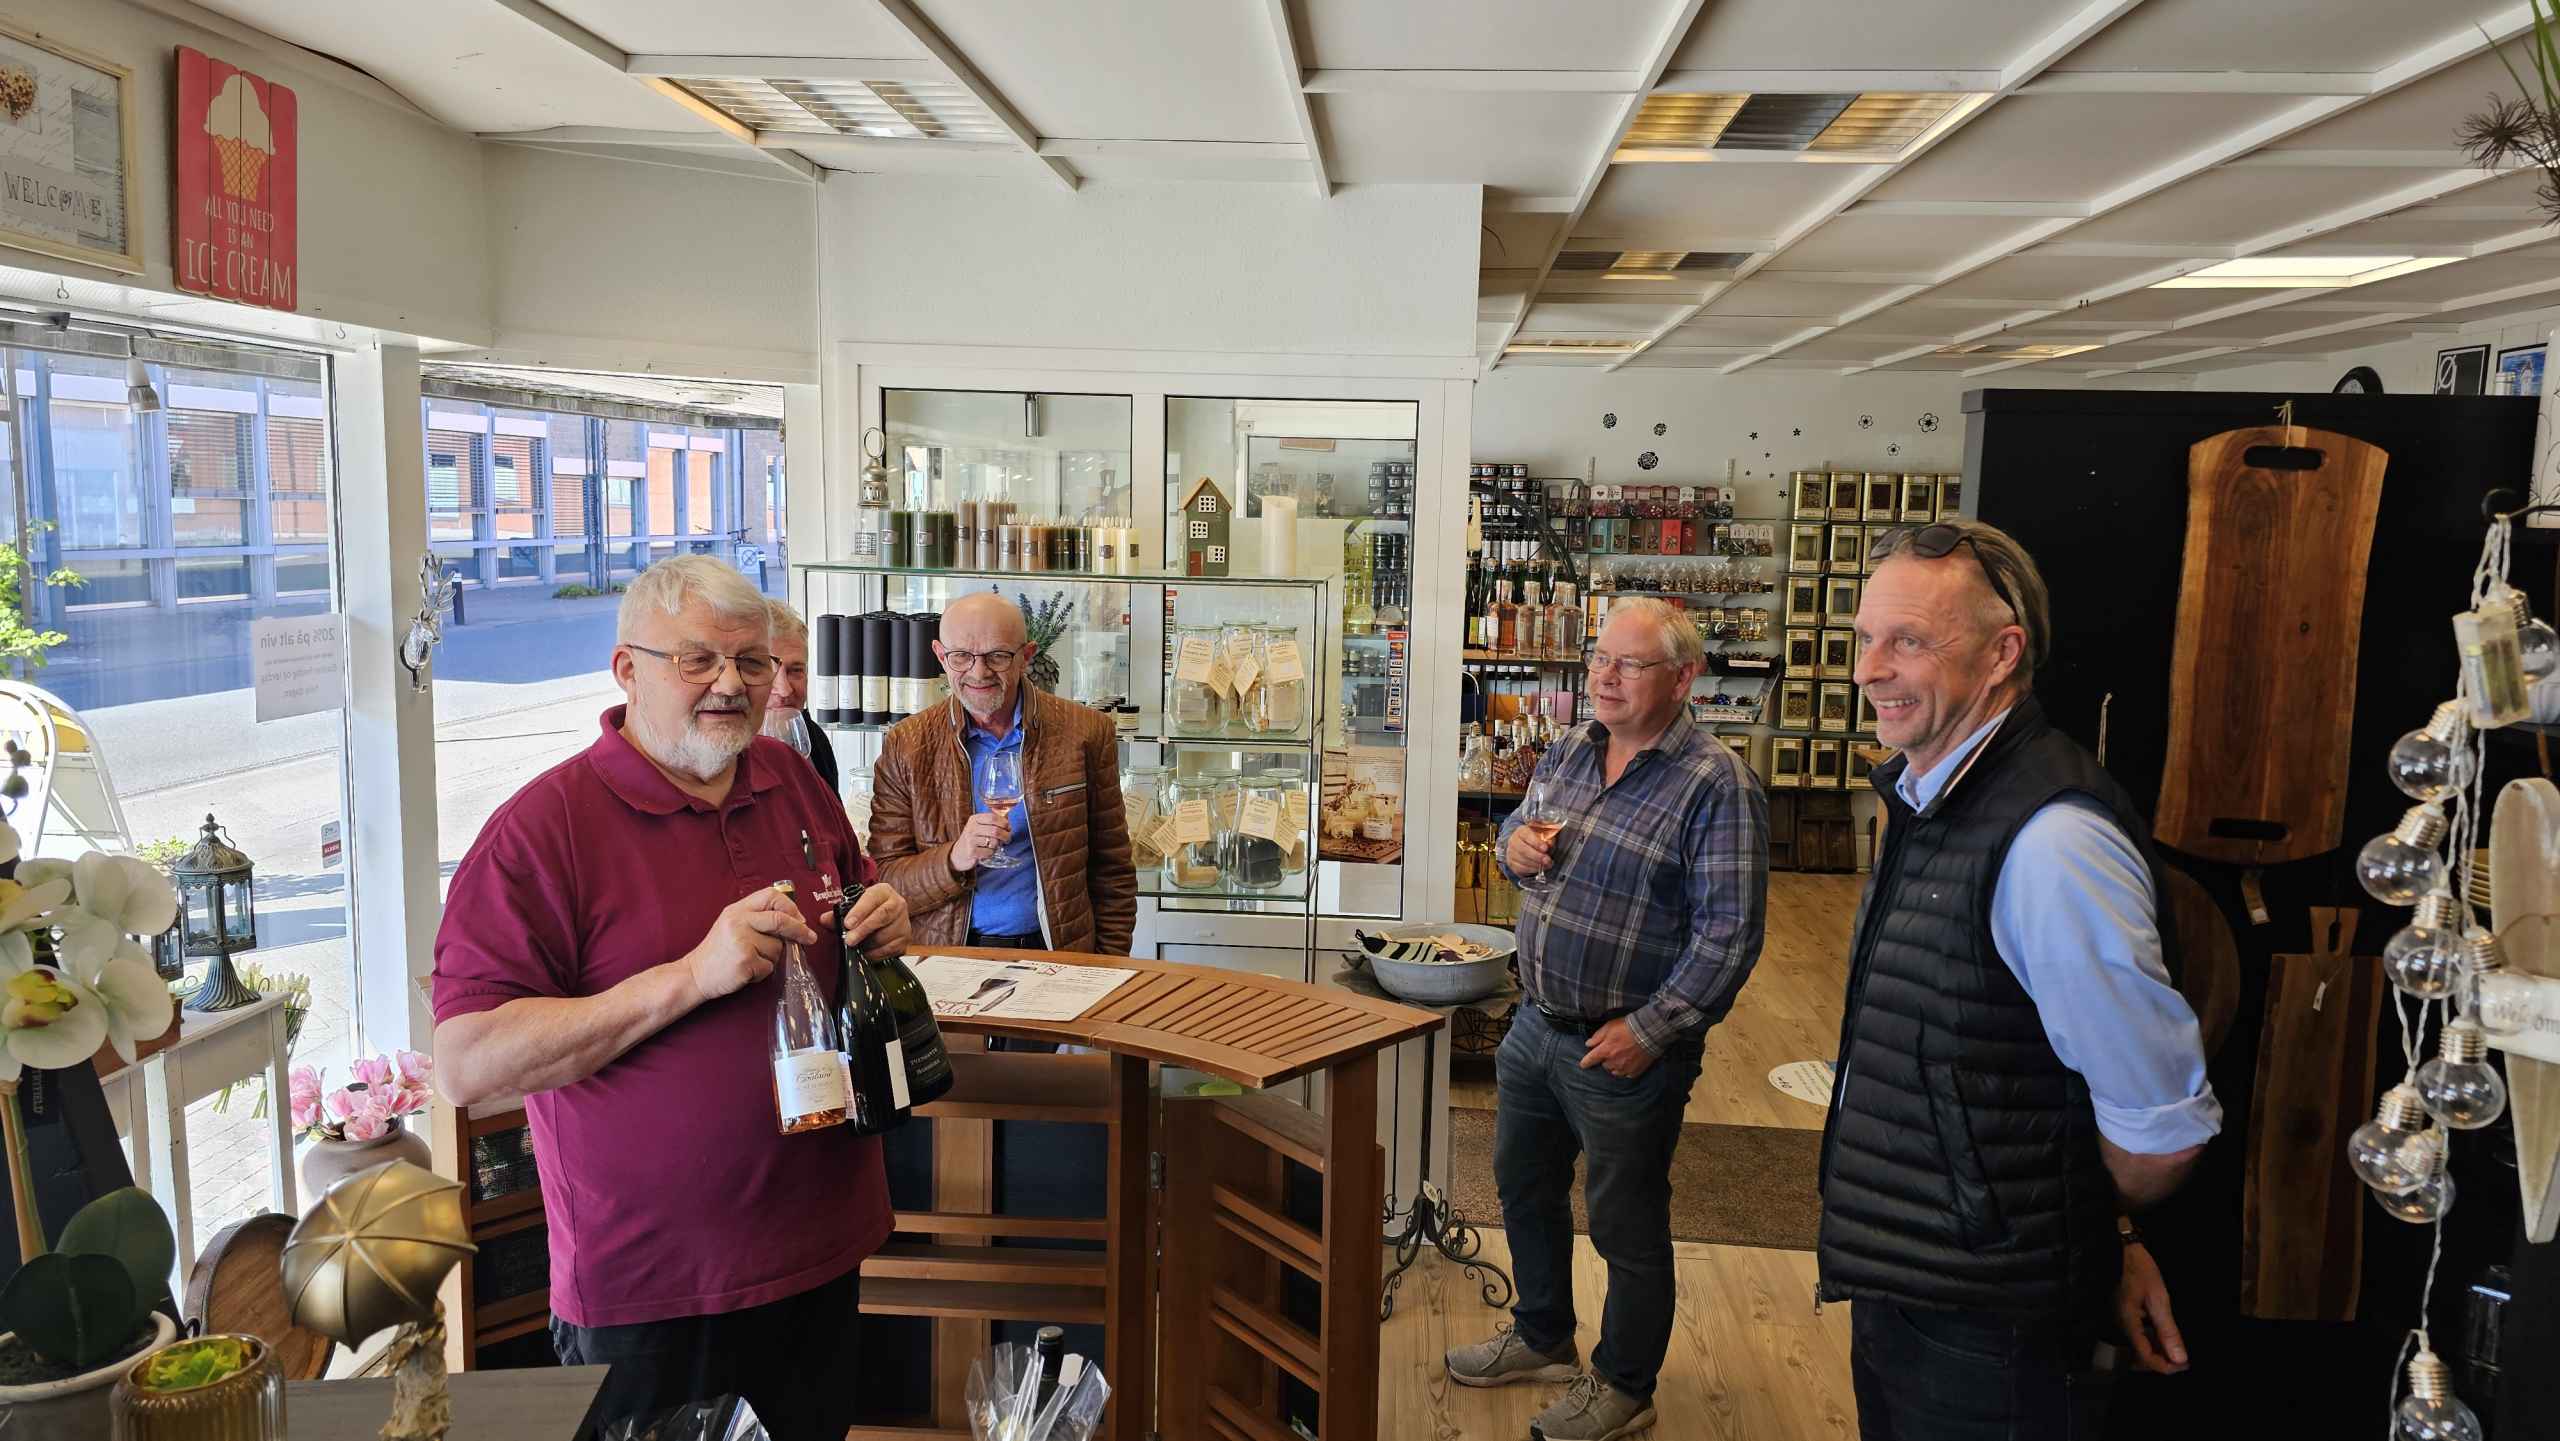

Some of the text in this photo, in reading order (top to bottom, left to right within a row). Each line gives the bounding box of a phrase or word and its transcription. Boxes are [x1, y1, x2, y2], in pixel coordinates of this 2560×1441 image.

[4, 170, 102, 219] WELCOME
[205, 194, 274, 233] ALL YOU NEED
[227, 227, 254, 249] IS AN
[185, 238, 291, 306] ICE CREAM
